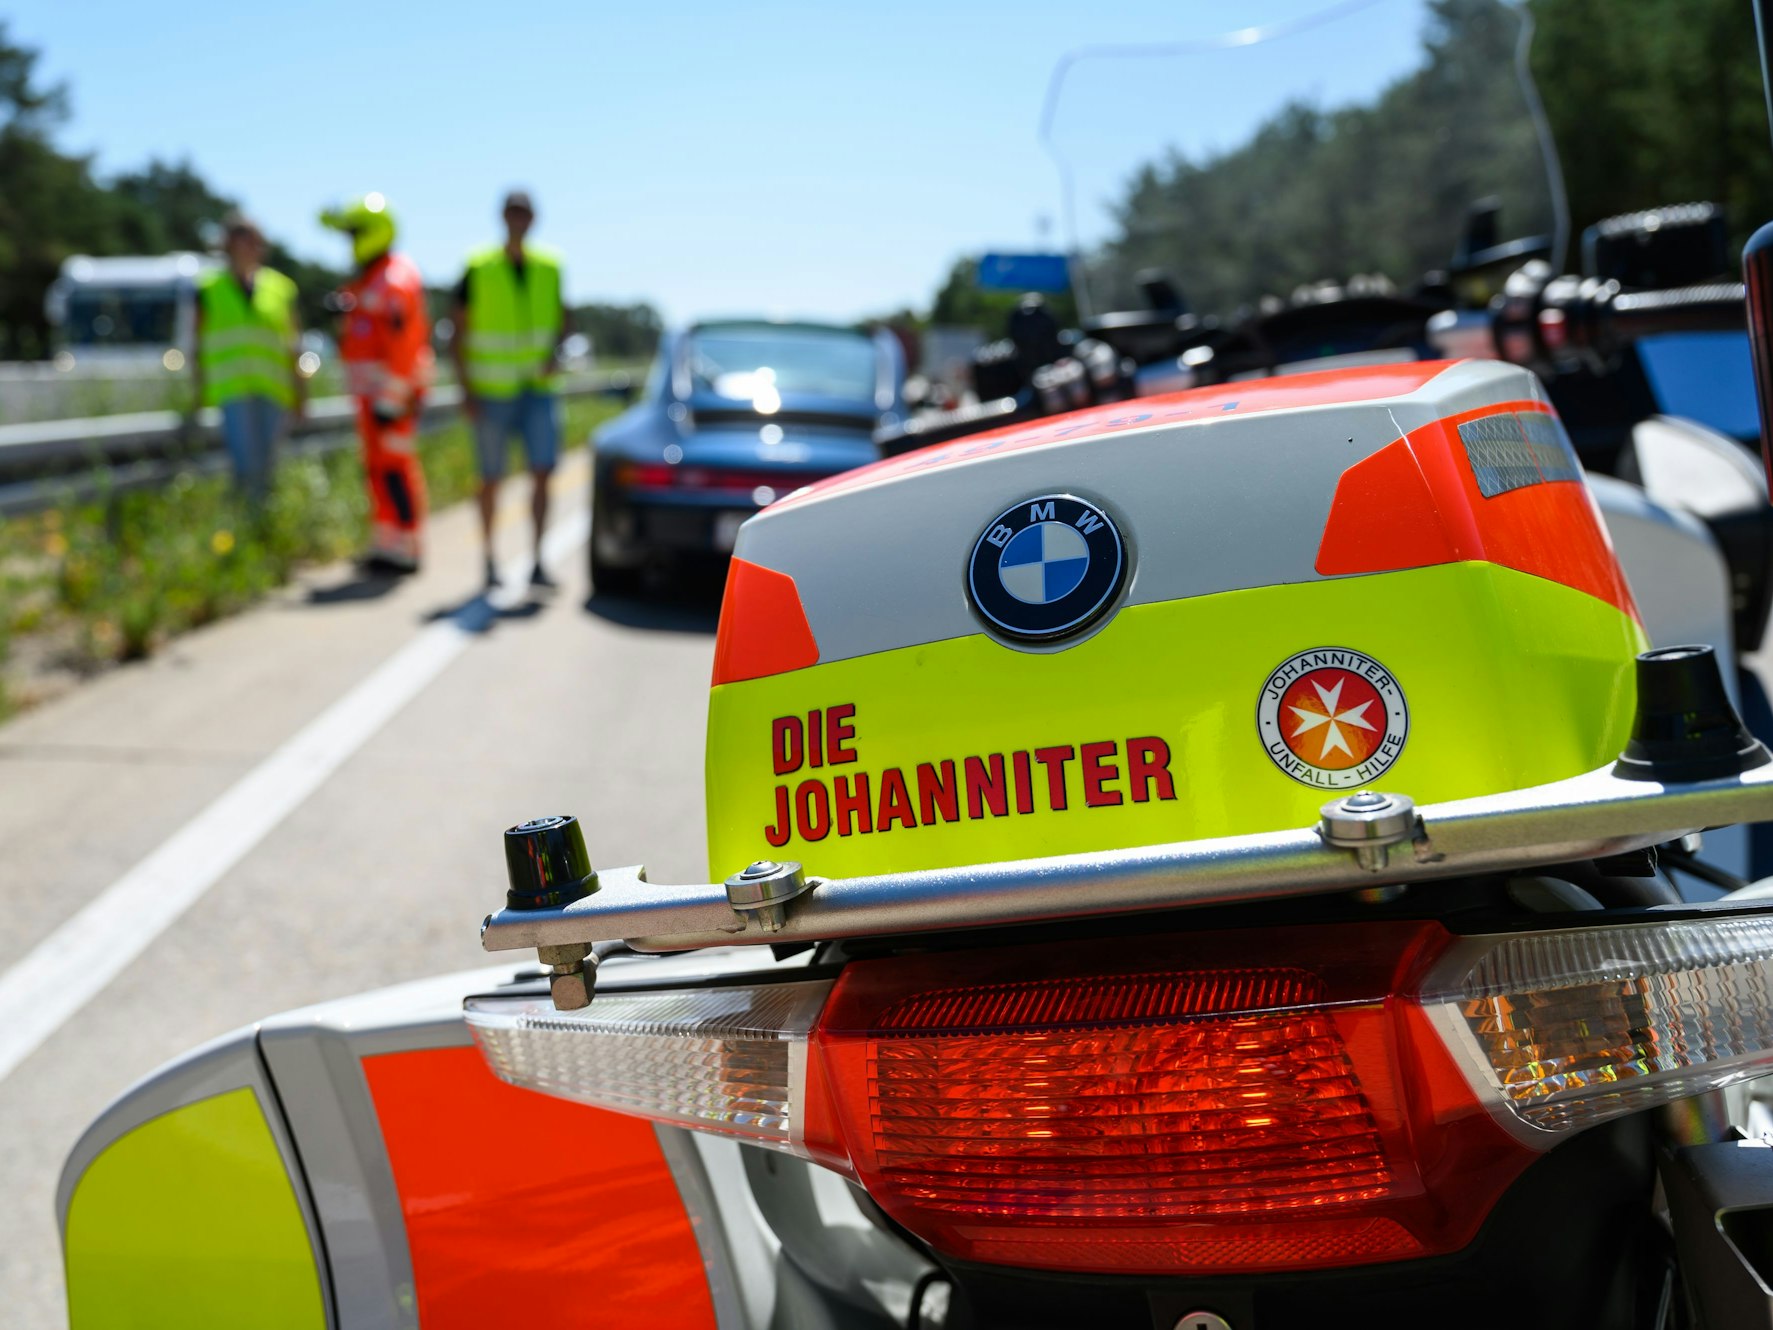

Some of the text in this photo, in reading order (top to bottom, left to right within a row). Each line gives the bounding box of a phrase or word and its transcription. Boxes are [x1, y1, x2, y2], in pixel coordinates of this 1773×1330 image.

[986, 501, 1104, 548] BMW
[772, 703, 857, 776] DIE
[765, 736, 1178, 847] JOHANNITER
